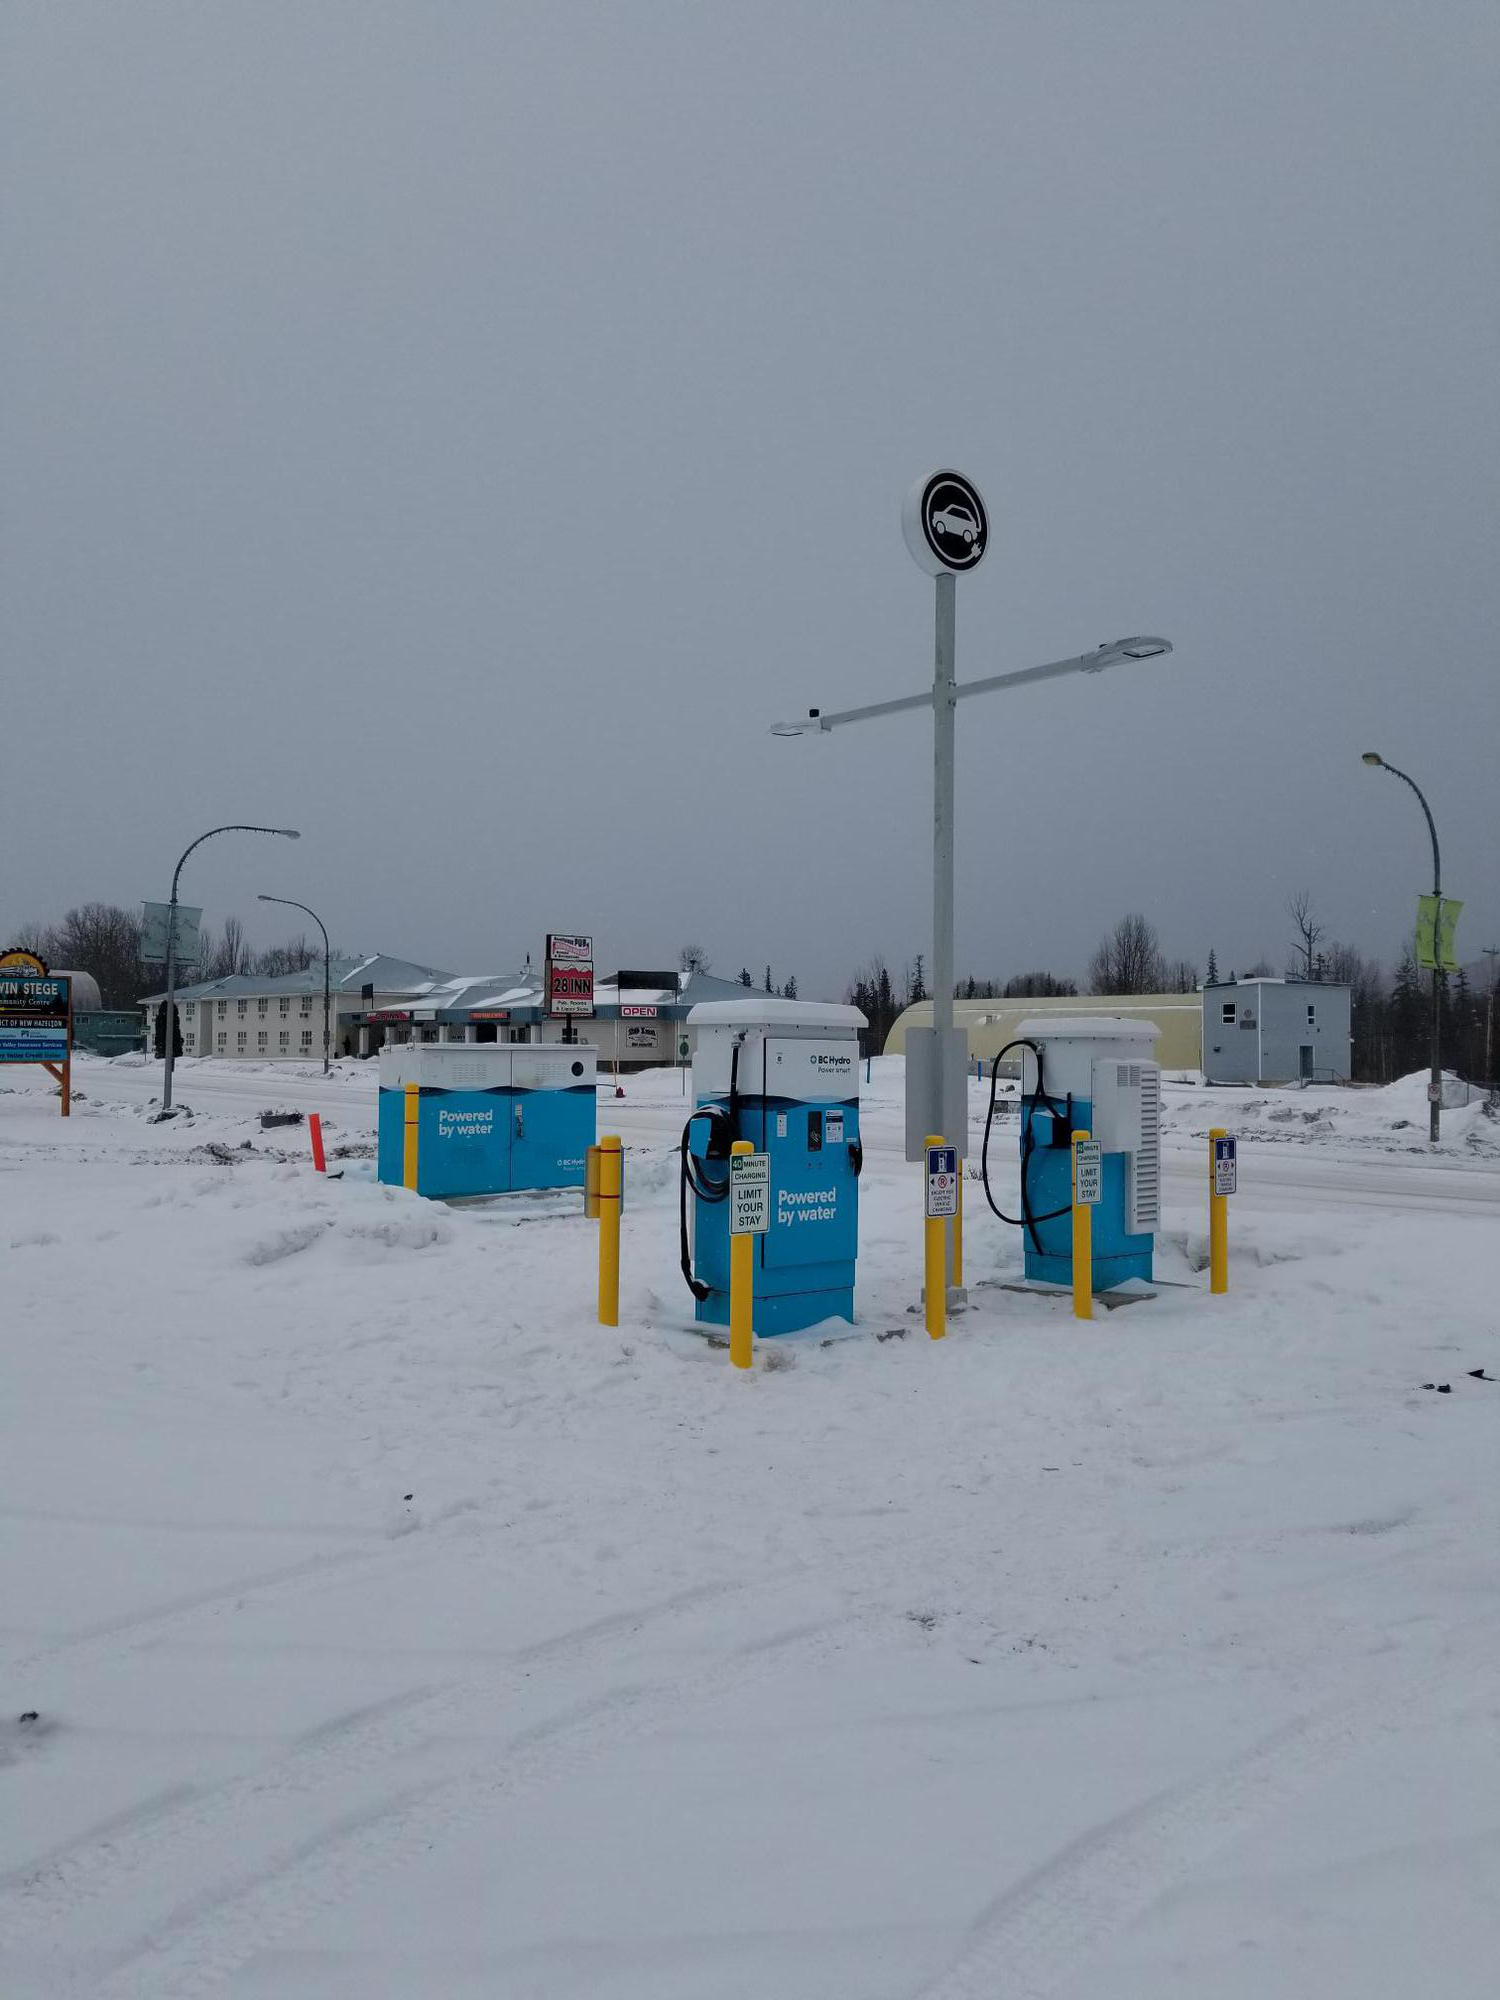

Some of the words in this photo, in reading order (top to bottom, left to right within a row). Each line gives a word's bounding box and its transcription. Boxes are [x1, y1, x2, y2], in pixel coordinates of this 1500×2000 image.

[23, 982, 59, 996] STEGE
[554, 978, 568, 993] 28
[571, 978, 591, 994] INN
[623, 1007, 656, 1016] OPEN
[10, 1019, 18, 1027] OF
[19, 1019, 33, 1027] NEW
[34, 1019, 63, 1028] HAZELTON
[818, 1055, 829, 1064] BC
[829, 1055, 851, 1066] Hydro
[439, 1109, 493, 1122] Powered
[438, 1124, 456, 1138] by
[457, 1124, 493, 1135] water
[571, 1159, 585, 1167] Hydr
[732, 1160, 742, 1169] 40
[743, 1160, 766, 1168] MINUTE
[734, 1171, 766, 1180] CHARGING
[1080, 1168, 1098, 1177] LIMIT
[1080, 1179, 1098, 1188] YOUR
[738, 1188, 763, 1200] LIMIT
[778, 1186, 836, 1205] Powered
[1081, 1189, 1097, 1199] STAY
[737, 1201, 764, 1213] YOUR
[738, 1214, 762, 1227] STAY
[778, 1207, 795, 1227] by
[797, 1206, 837, 1222] water
